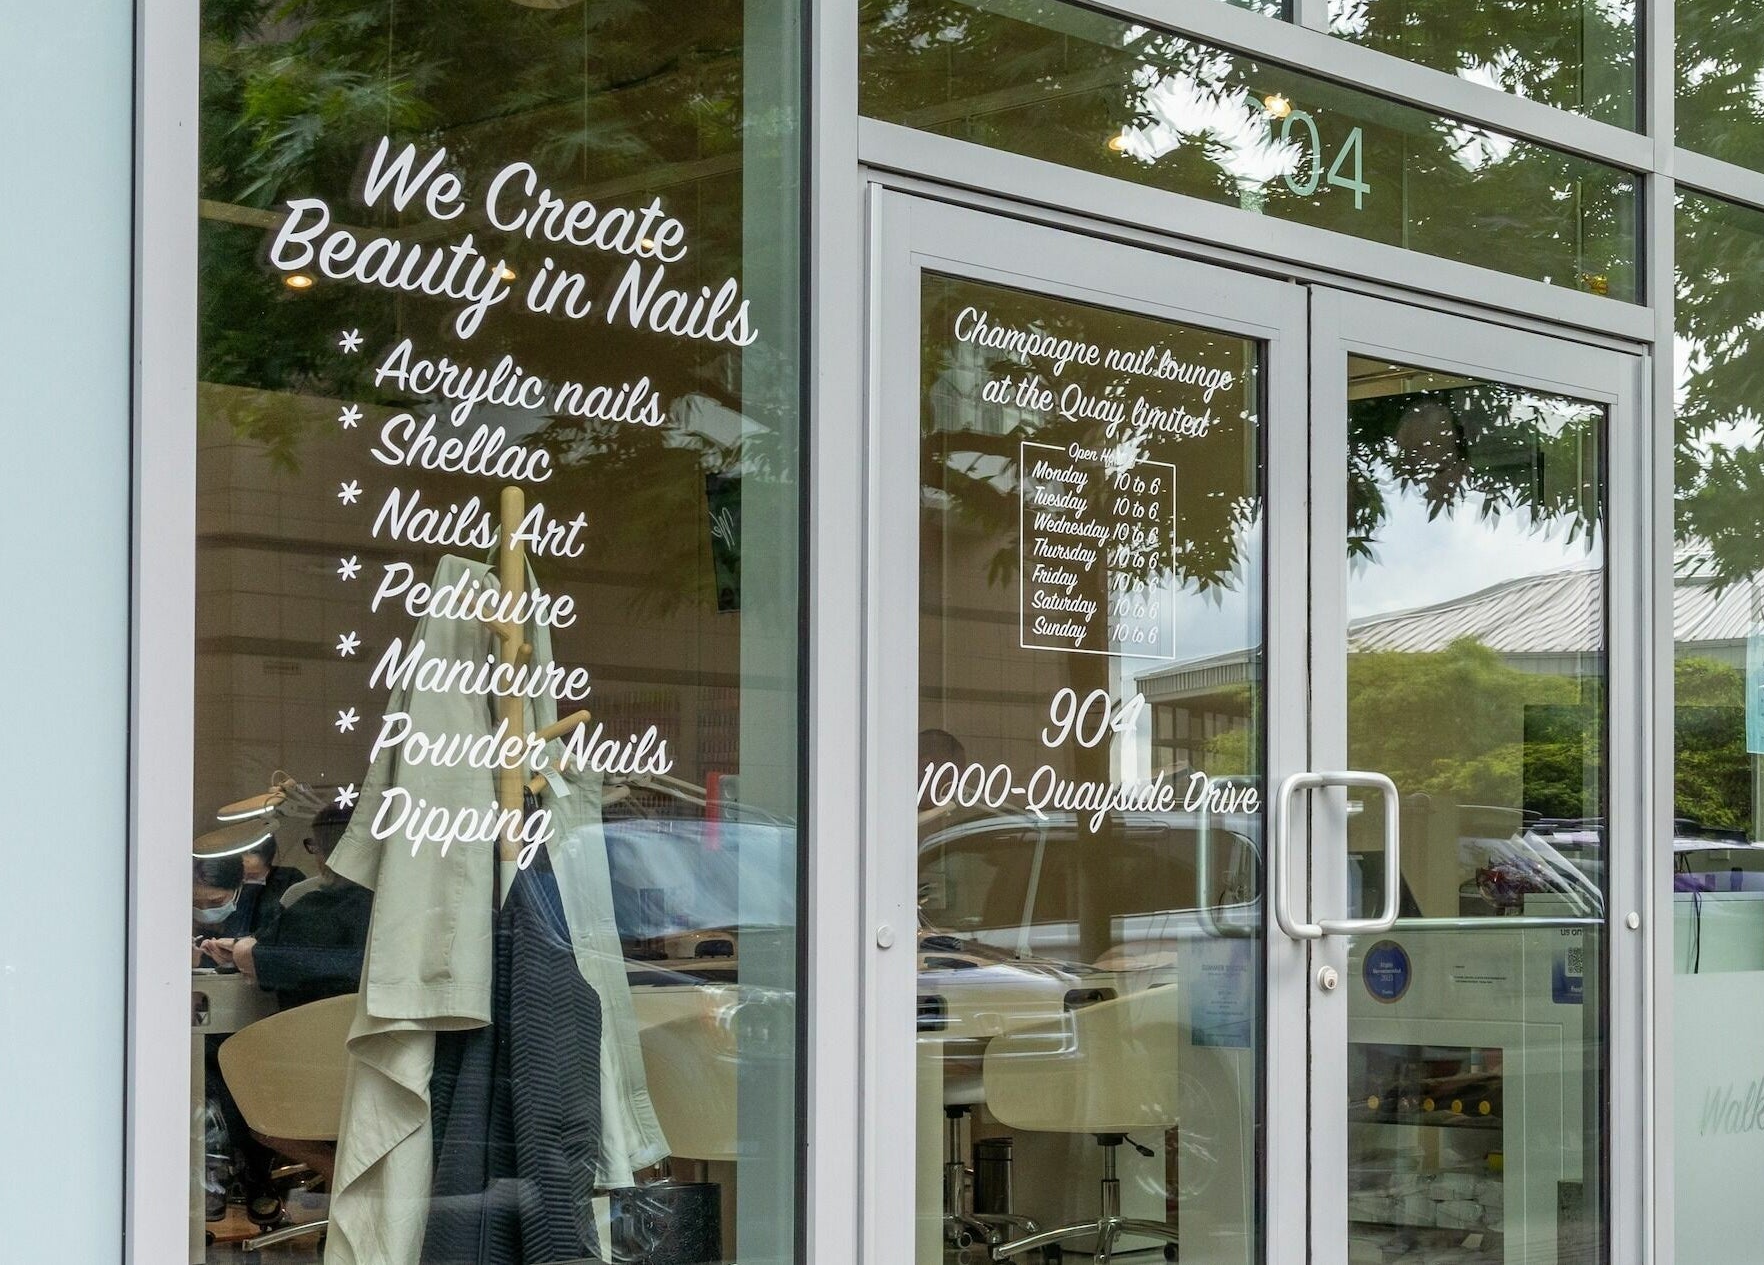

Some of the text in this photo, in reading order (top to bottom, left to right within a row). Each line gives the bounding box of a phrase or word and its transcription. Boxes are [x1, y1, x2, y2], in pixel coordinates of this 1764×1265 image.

[363, 135, 689, 264] We Create
[269, 198, 759, 347] Beauty in Nails
[374, 338, 667, 428] Acrylic nails
[954, 306, 1234, 403] Champagne nail lounge
[982, 375, 1211, 439] at the Quay limited
[370, 412, 553, 483] Shellac
[1031, 460, 1161, 496] Monday 10 to 6
[1068, 442, 1098, 463] Open
[371, 486, 589, 558] Nails Art
[1032, 486, 1161, 520] Tuesday 10 to 6
[1033, 511, 1161, 548] Wednesday 10 to 6
[1031, 564, 1078, 595] Friday
[1032, 537, 1097, 571] Thursday
[371, 562, 577, 629] Pedicure
[1031, 590, 1097, 622] Saturday
[1031, 615, 1087, 647] Sunday
[368, 637, 592, 701] Manicure
[368, 711, 674, 776] Powder Nails
[1041, 687, 1146, 750] 904
[370, 786, 554, 870] Dipping
[917, 761, 1260, 833] 1000-Quayside Drive
